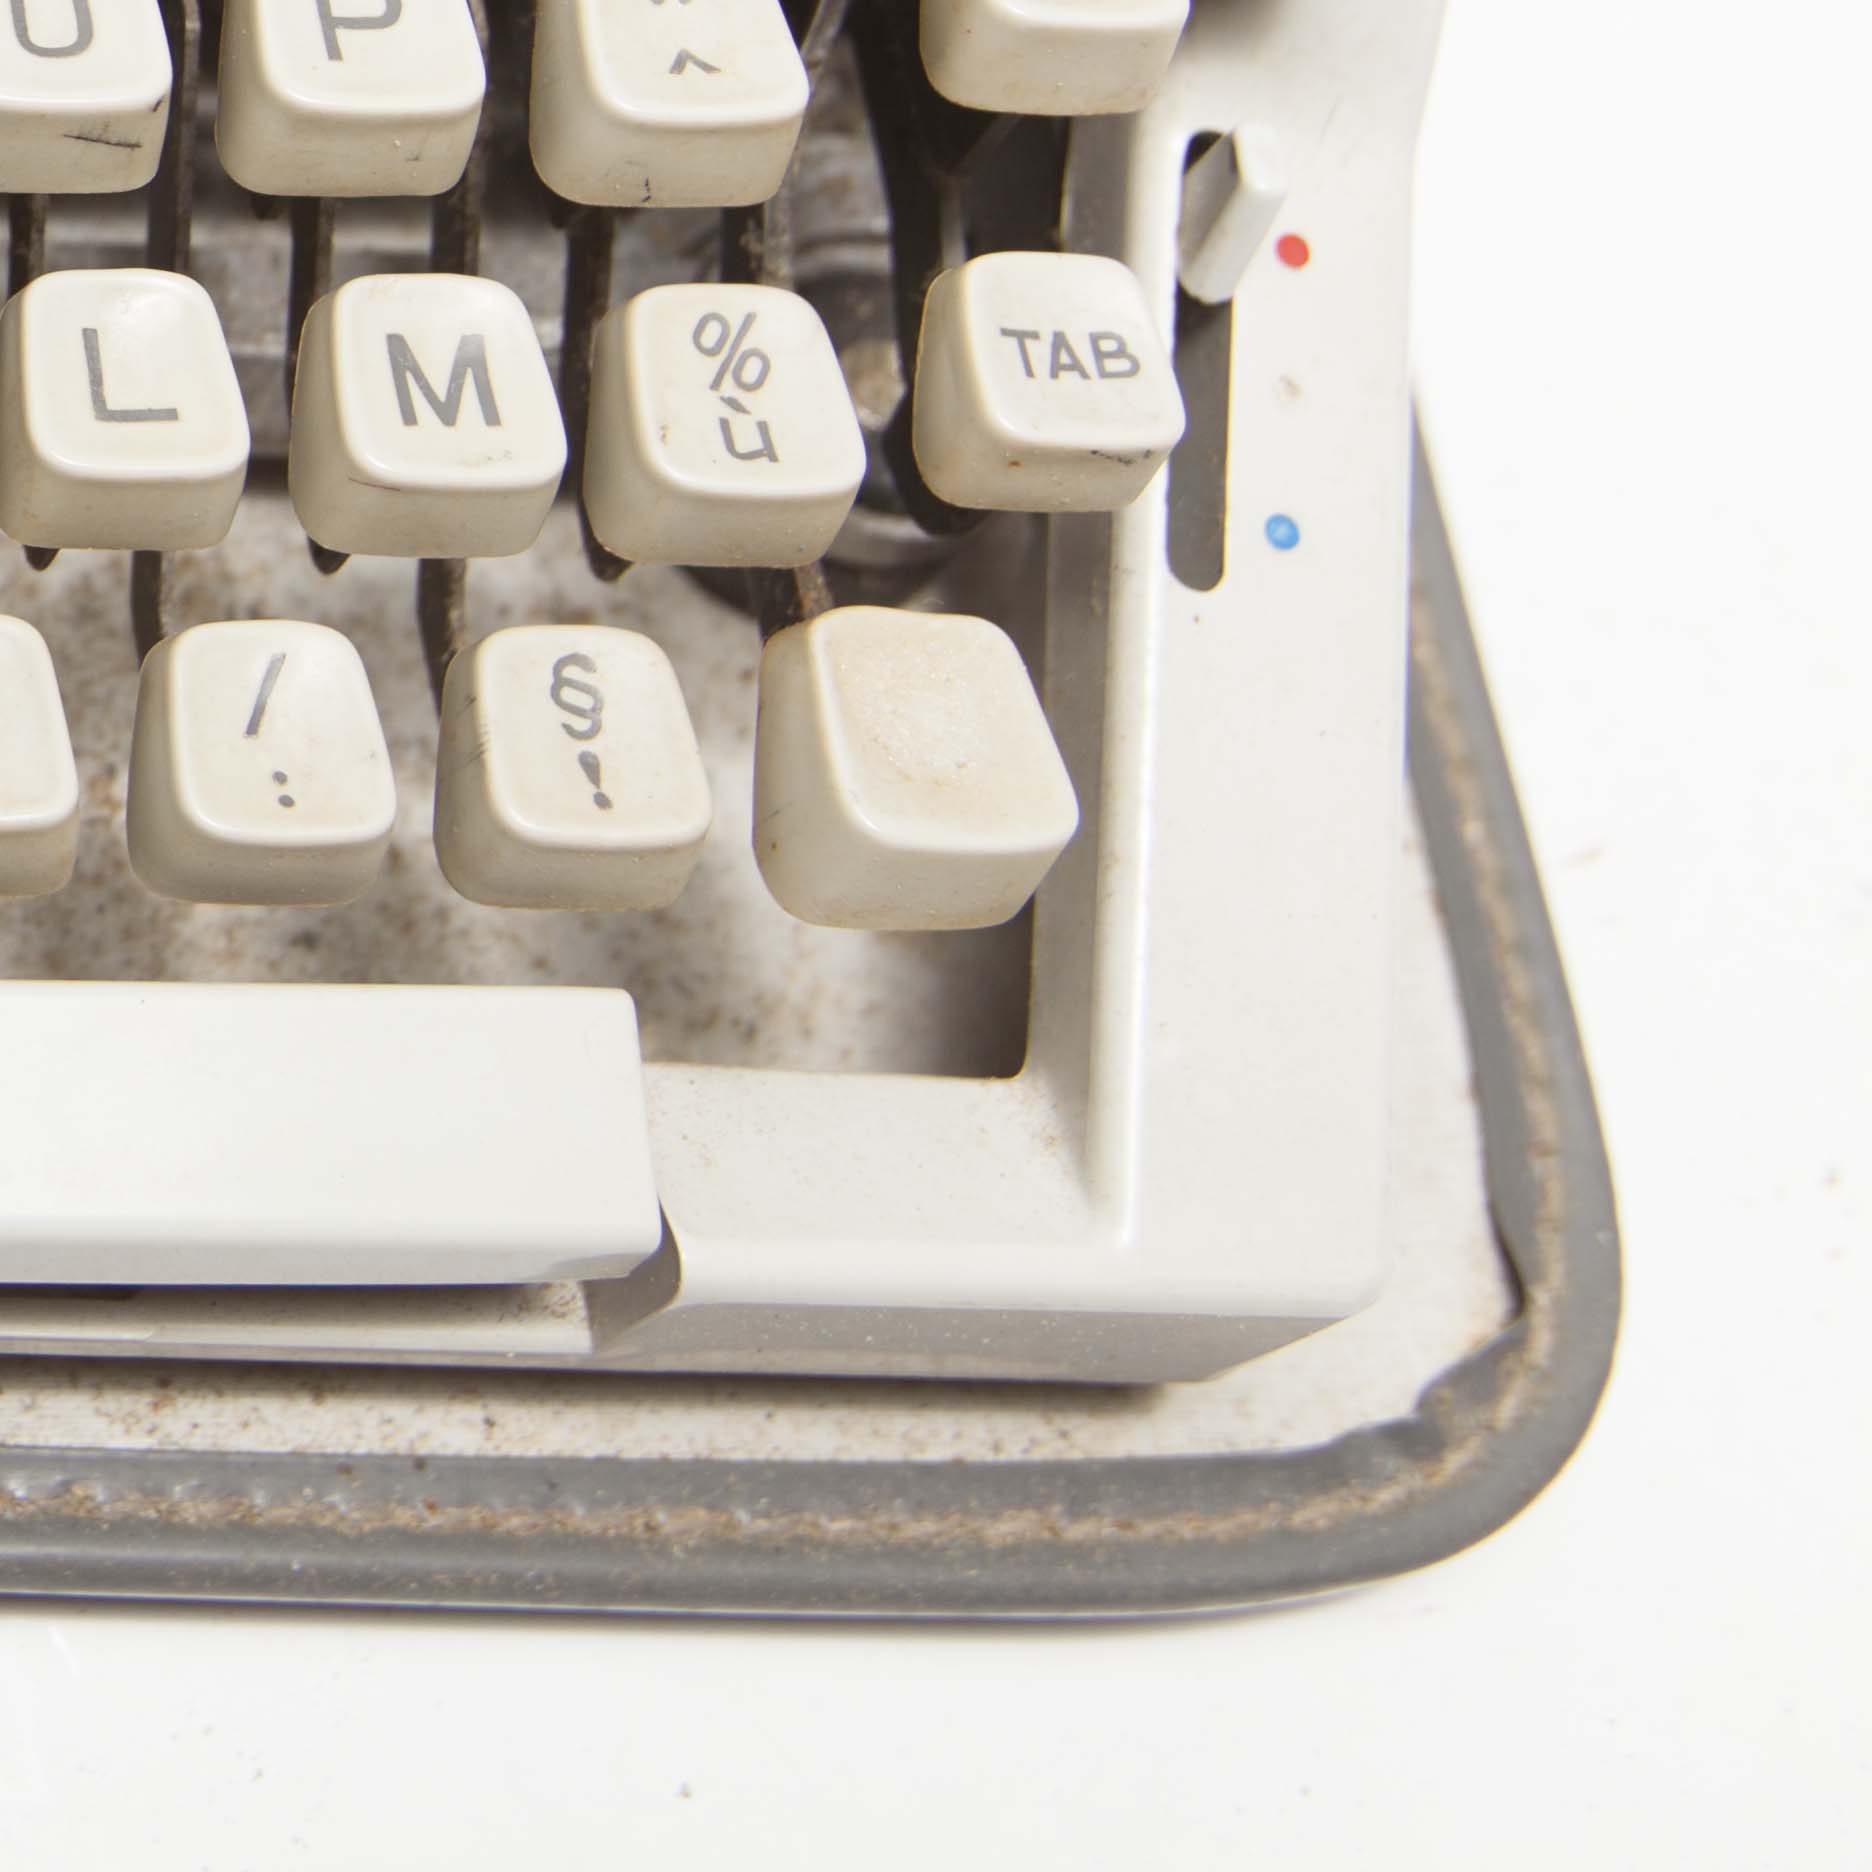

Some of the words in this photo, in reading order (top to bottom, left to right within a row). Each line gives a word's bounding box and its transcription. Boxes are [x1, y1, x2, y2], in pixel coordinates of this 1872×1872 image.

[80, 326, 181, 425] L
[384, 331, 503, 429] M
[690, 310, 773, 394] %
[998, 326, 1142, 382] TAB
